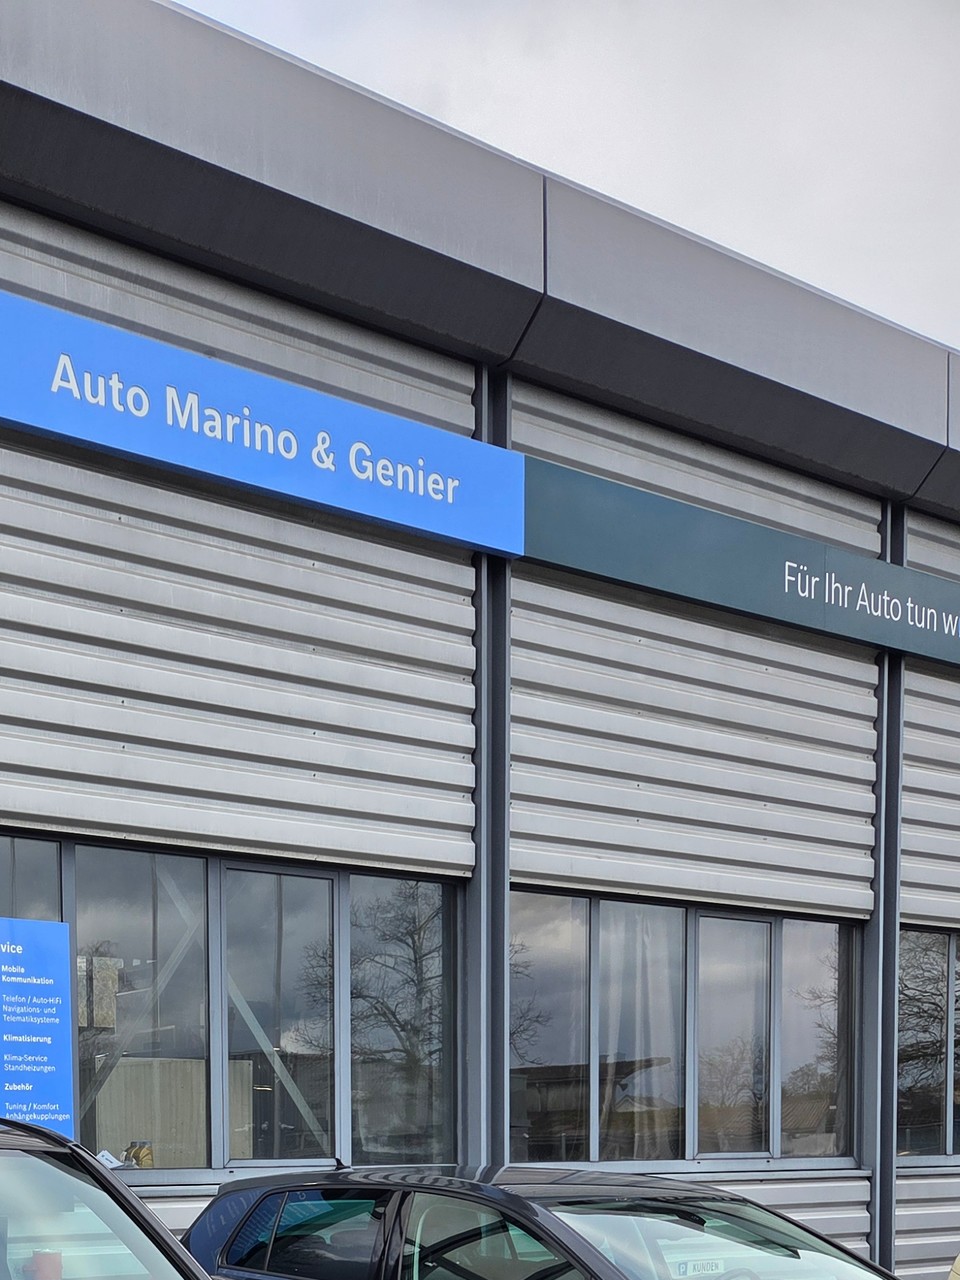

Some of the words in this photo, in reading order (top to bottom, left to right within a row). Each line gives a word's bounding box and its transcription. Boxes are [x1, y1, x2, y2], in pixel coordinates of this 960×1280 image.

[50, 352, 150, 418] Auto
[166, 386, 298, 461] Marino
[311, 431, 337, 472] &
[348, 441, 460, 504] Genier
[784, 561, 820, 600] Für
[824, 571, 853, 608] Ihr
[856, 582, 902, 622] Auto
[906, 596, 937, 632] tun
[942, 612, 960, 637] w
[2, 965, 25, 974] Mobile
[2, 975, 53, 984] Kommunikation
[2, 995, 26, 1003] Telefon
[3, 1005, 42, 1014] Navigations-
[44, 1006, 56, 1014] und
[3, 1015, 60, 1024] Telematiksysteme
[3, 1034, 51, 1044] Klimatisierung
[4, 1054, 48, 1063] Klima-Service
[4, 1064, 56, 1073] Standheizungen
[5, 1082, 33, 1091] Zubehör
[5, 1103, 27, 1112] Tuning
[33, 1103, 59, 1111] Komfort
[692, 1262, 719, 1273] KUNDEN
